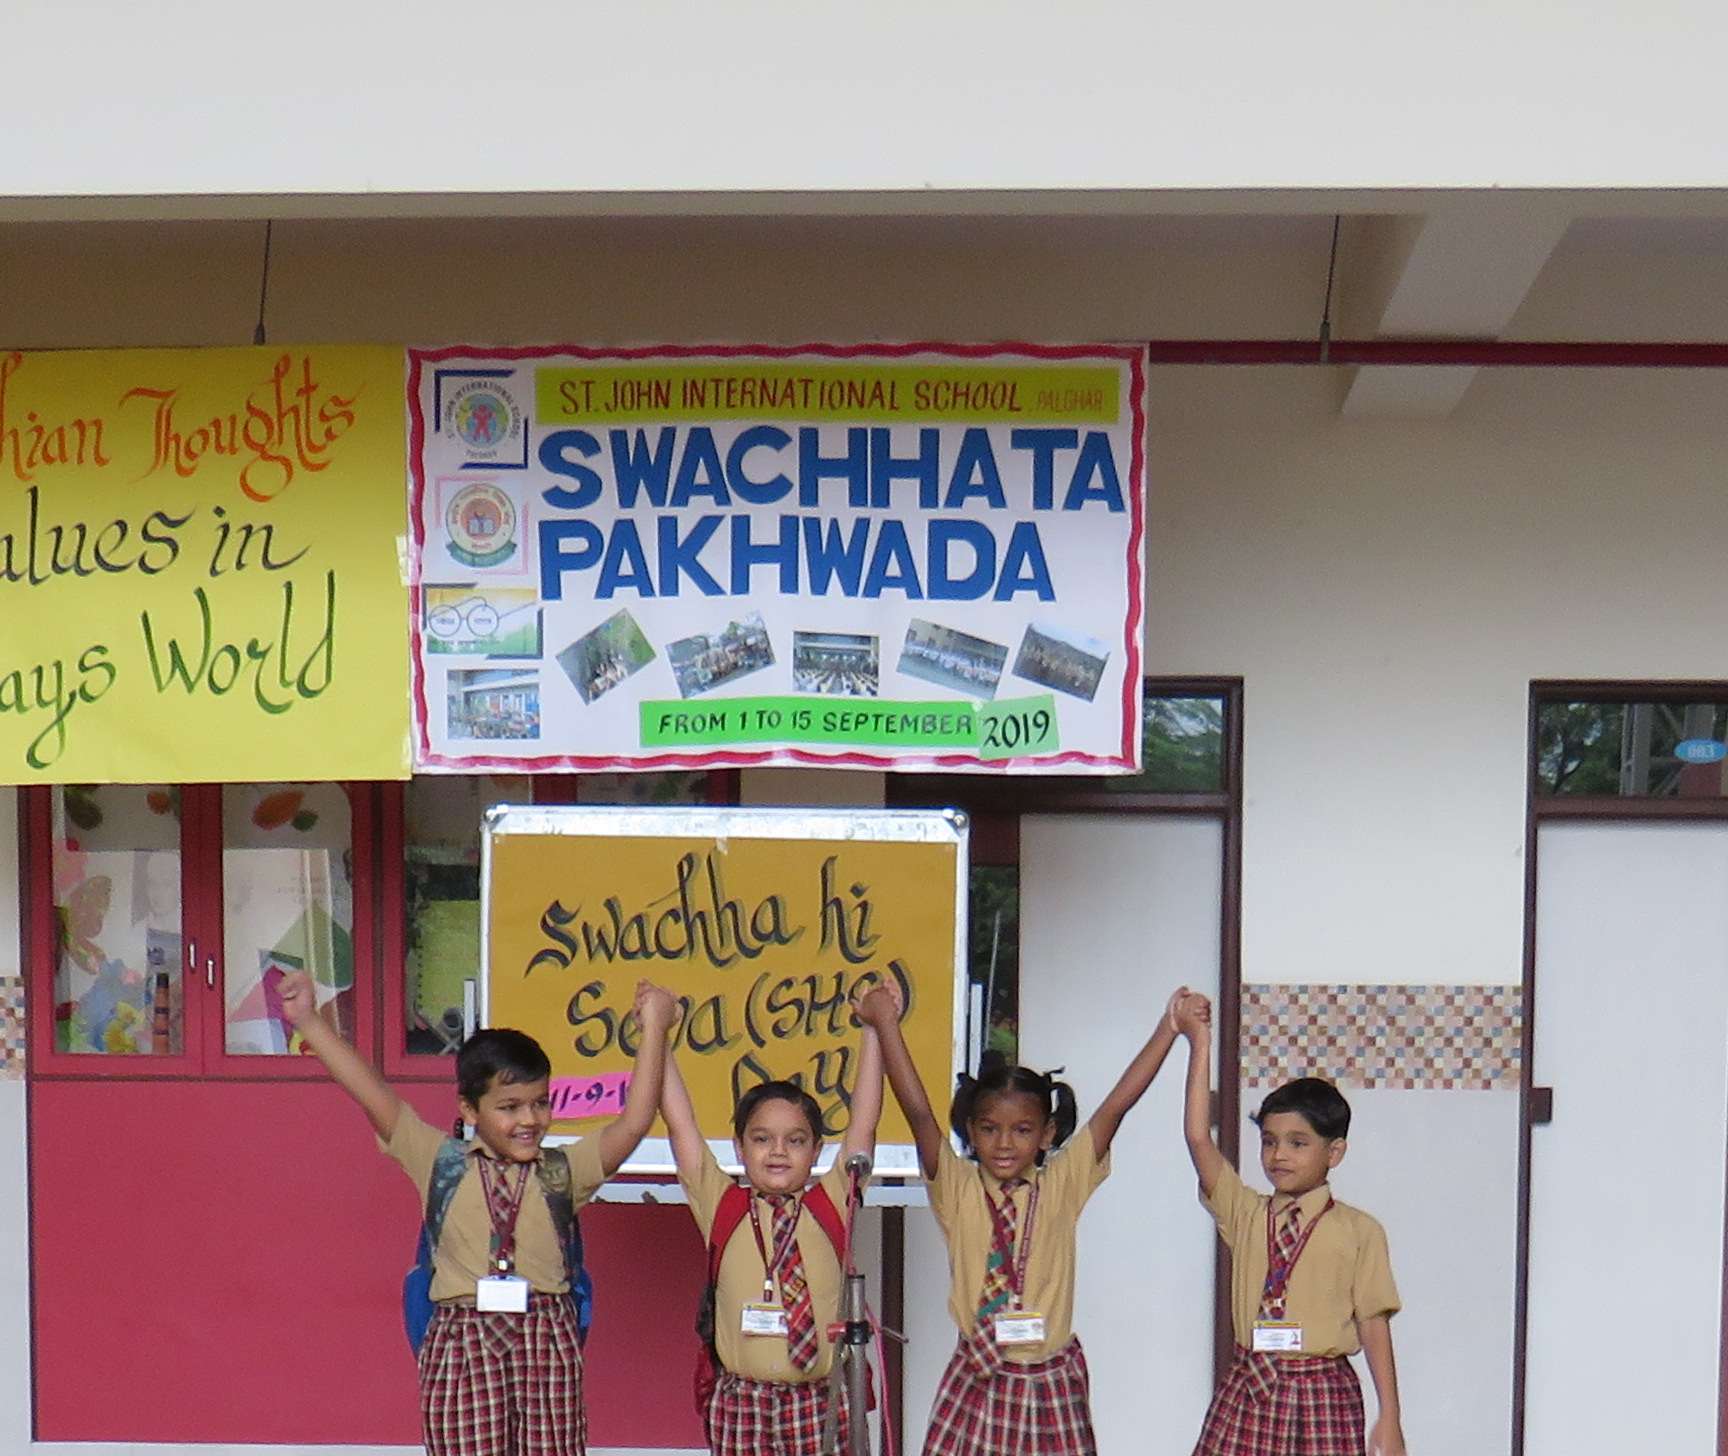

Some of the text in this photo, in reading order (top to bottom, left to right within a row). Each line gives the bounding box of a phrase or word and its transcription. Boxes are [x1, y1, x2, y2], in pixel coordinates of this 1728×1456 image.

[119, 354, 368, 502] Thoughts
[559, 379, 601, 415] ST.
[612, 382, 670, 411] JOHN
[681, 377, 899, 411] INTERNATIONAL
[915, 379, 1023, 413] SCHOOL
[538, 425, 1125, 513] SWACHHATA
[209, 505, 313, 577] in
[538, 514, 1056, 603] PAKHWADA
[141, 569, 335, 715] World
[660, 709, 1052, 750] FROM 1 TO 15 SEPTEMBER 2019
[525, 850, 879, 977] Swachha hi
